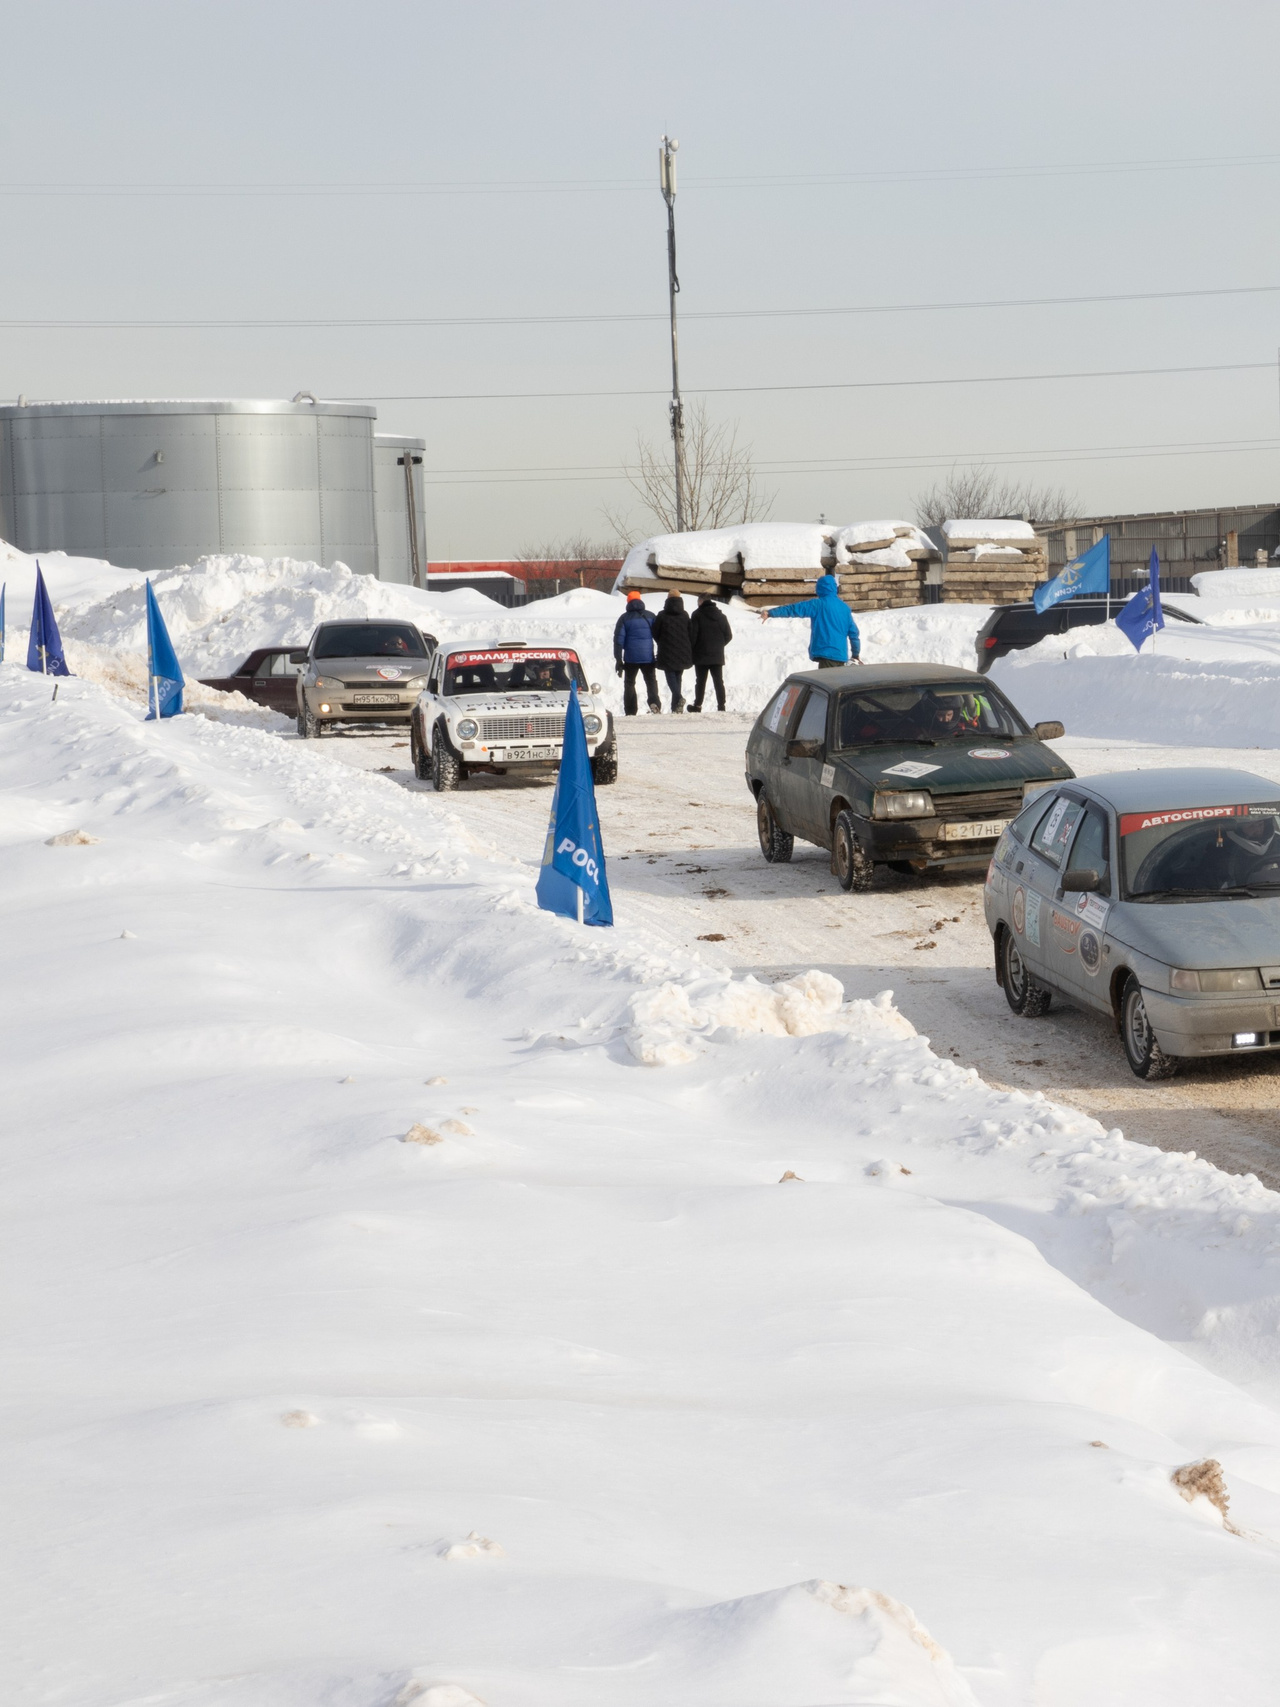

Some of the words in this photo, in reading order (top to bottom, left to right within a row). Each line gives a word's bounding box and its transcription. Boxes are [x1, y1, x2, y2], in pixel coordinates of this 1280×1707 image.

[469, 653, 509, 662] РАЛЛИ
[512, 652, 557, 660] РОССИИ
[507, 750, 544, 760] В921НС
[1141, 808, 1233, 828] АВТОСПОРТ
[951, 823, 1000, 838] С217НЕ
